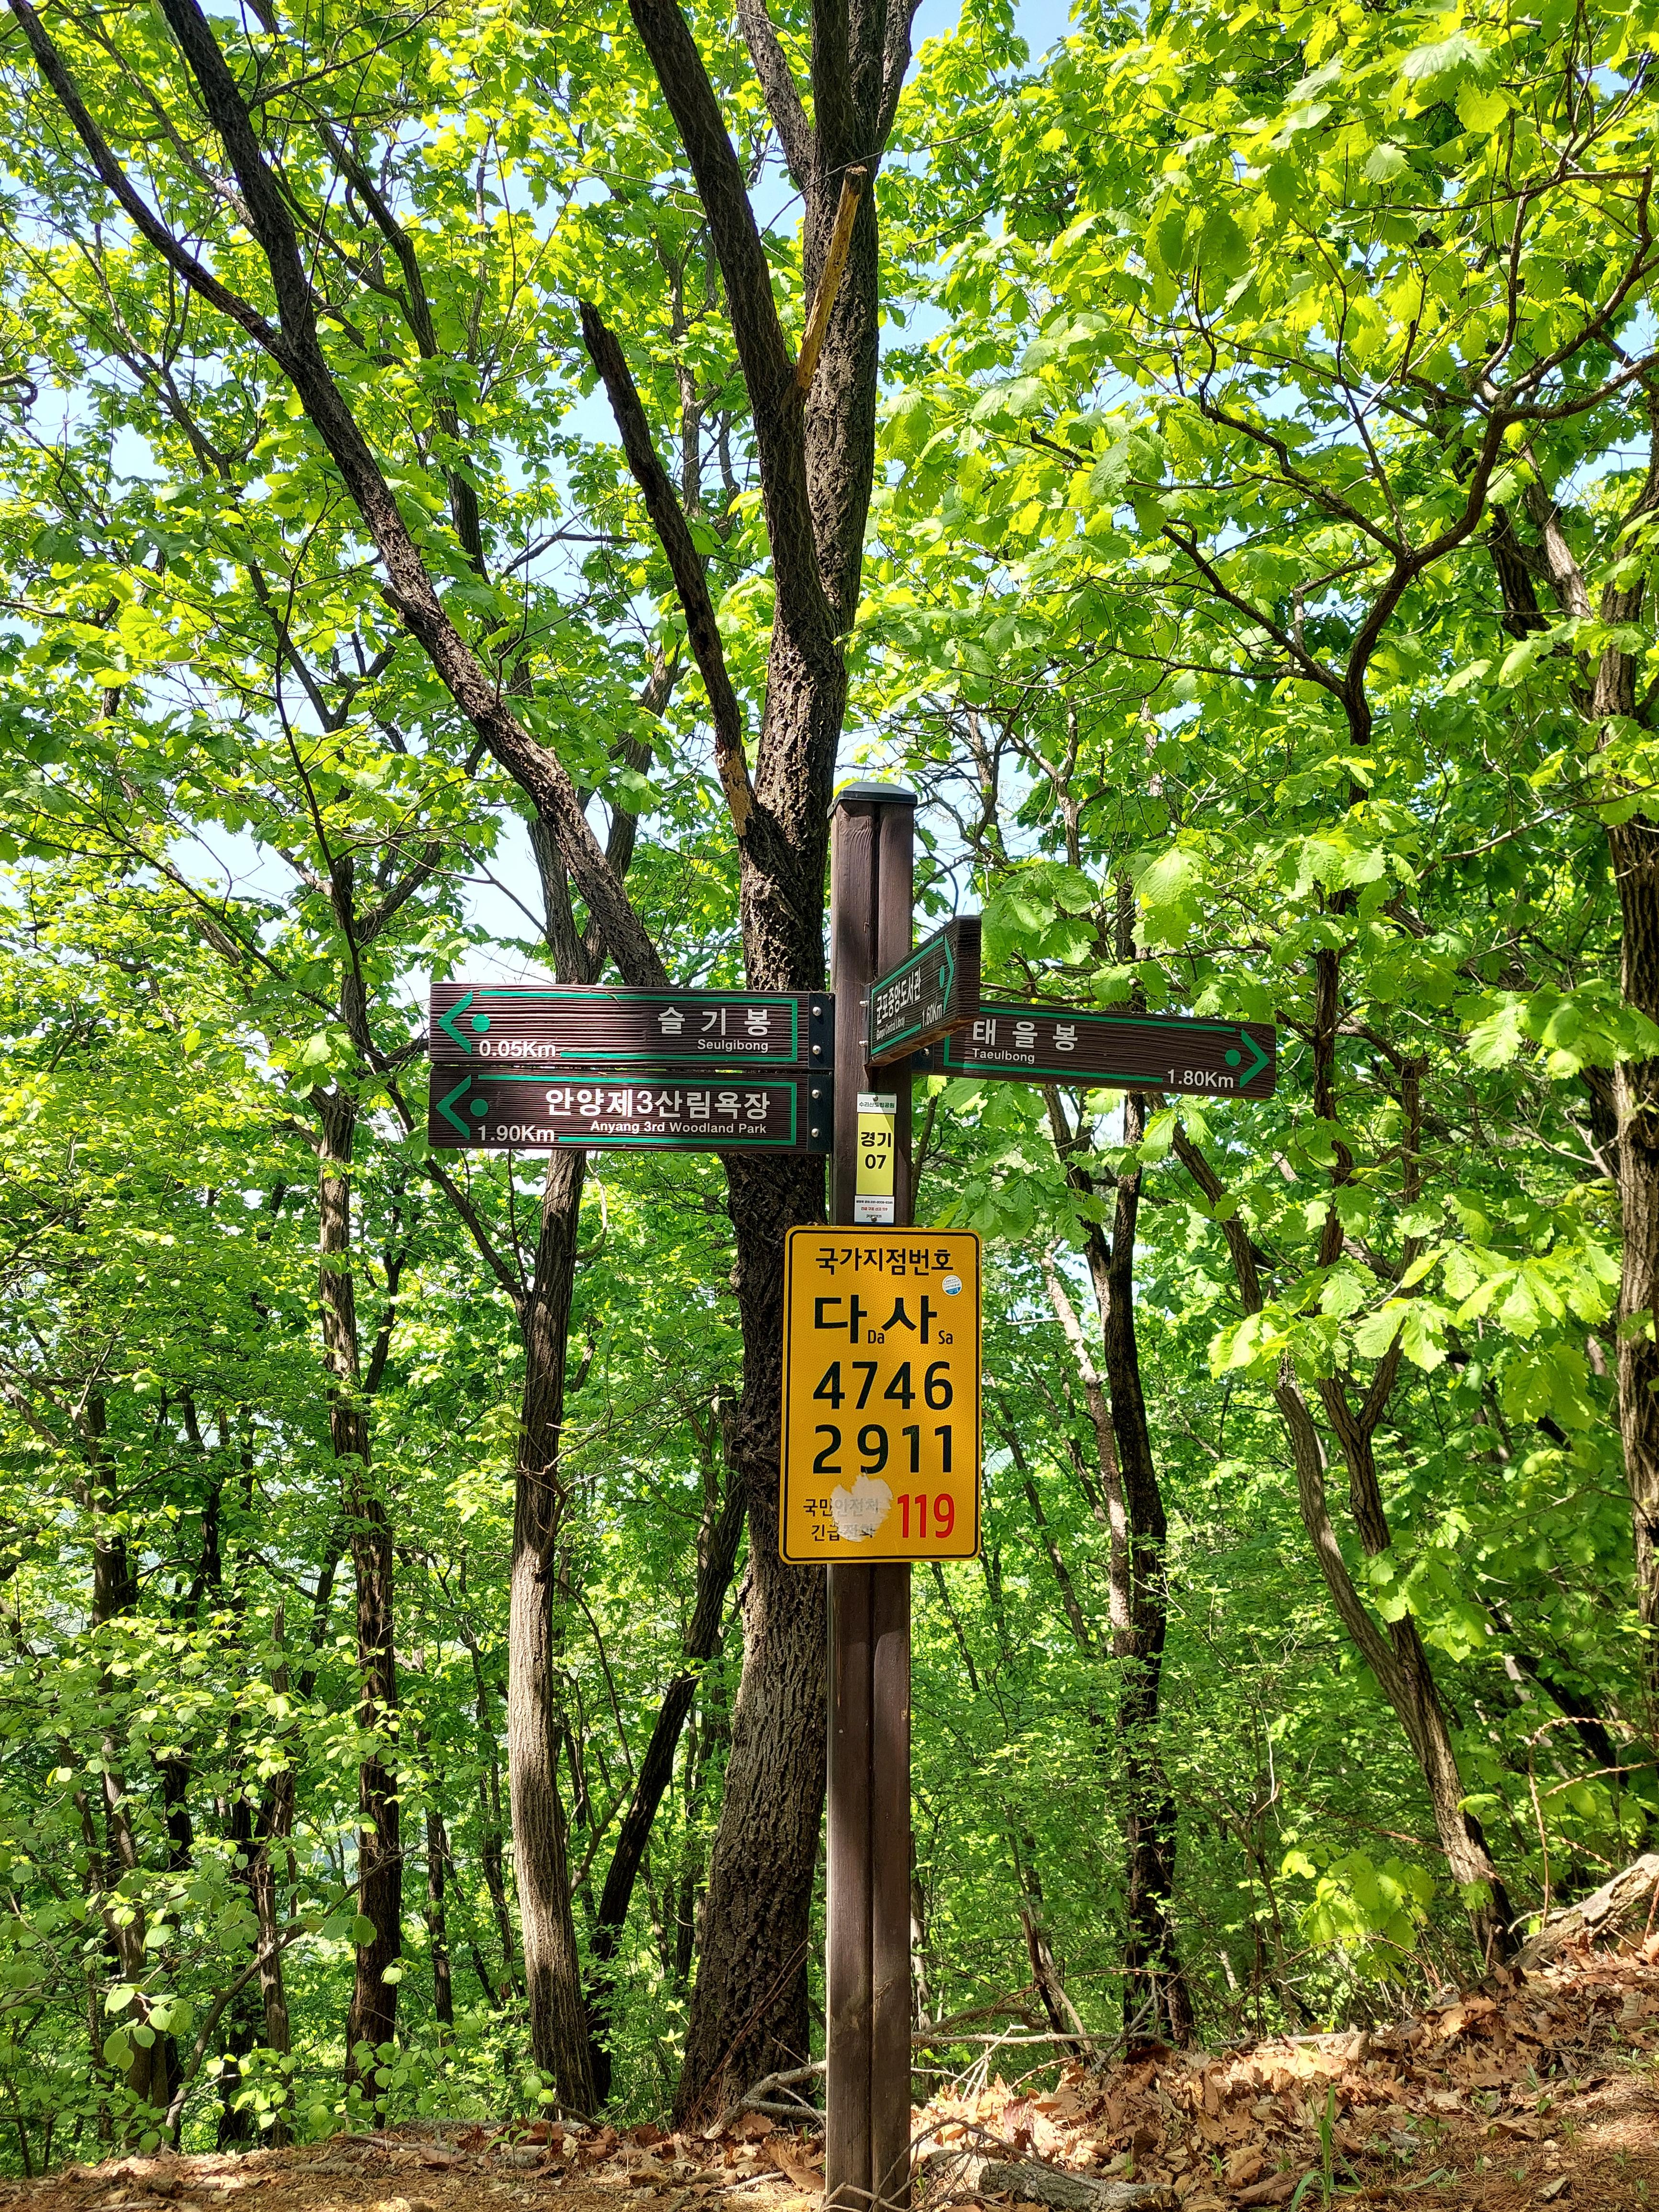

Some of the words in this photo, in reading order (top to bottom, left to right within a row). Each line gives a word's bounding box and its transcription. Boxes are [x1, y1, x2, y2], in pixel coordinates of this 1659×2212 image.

[876, 966, 921, 1025] 군포중앙도서관
[922, 1001, 942, 1028] 1.60Km
[479, 1040, 556, 1058] 0.05Km
[697, 1039, 768, 1053] Seulgibong
[972, 1048, 1035, 1064] Taeulbong
[1167, 1069, 1234, 1088] 1.80Km
[546, 1088, 770, 1120] 안양제3산림욕장
[478, 1125, 555, 1142] 1.90Km
[590, 1120, 640, 1134] Anyang
[644, 1121, 665, 1132] 3rd
[669, 1122, 734, 1133] Woodland
[739, 1123, 766, 1134] Park
[861, 1132, 891, 1148] 경기
[865, 1154, 886, 1169] 07
[816, 1248, 953, 1275] 국가지점번호
[814, 1294, 867, 1344] 다
[881, 1295, 937, 1344] 사
[868, 1330, 885, 1344] Da
[938, 1330, 953, 1344] Sa
[813, 1361, 953, 1410] 4746
[813, 1424, 952, 1474] 2911
[897, 1493, 955, 1538] 119
